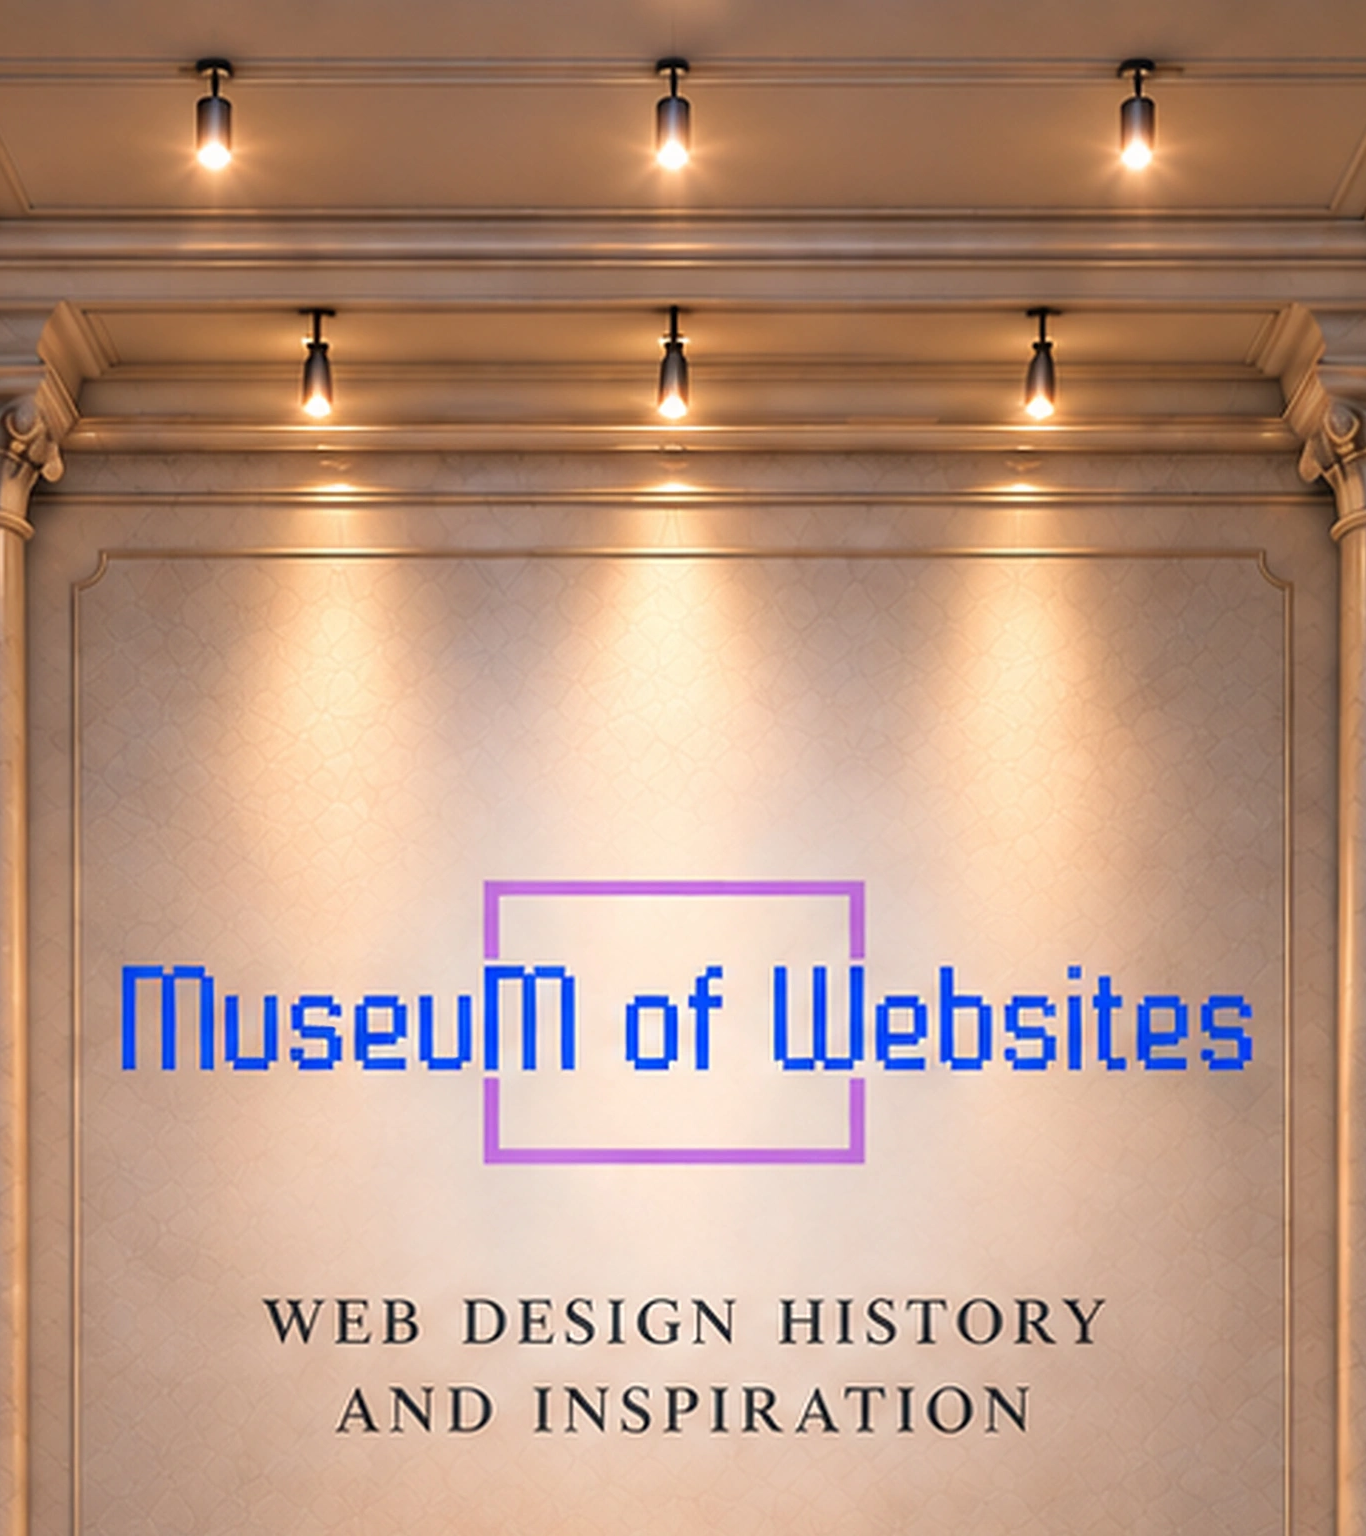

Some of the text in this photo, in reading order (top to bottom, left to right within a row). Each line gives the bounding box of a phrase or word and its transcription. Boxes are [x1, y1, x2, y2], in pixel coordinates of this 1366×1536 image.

[626, 966, 723, 1070] of
[773, 966, 1254, 1071] Websites
[263, 1298, 1105, 1345] WEB DESIGN HISTORY
[337, 1387, 1028, 1433] AND INSPIRATION
